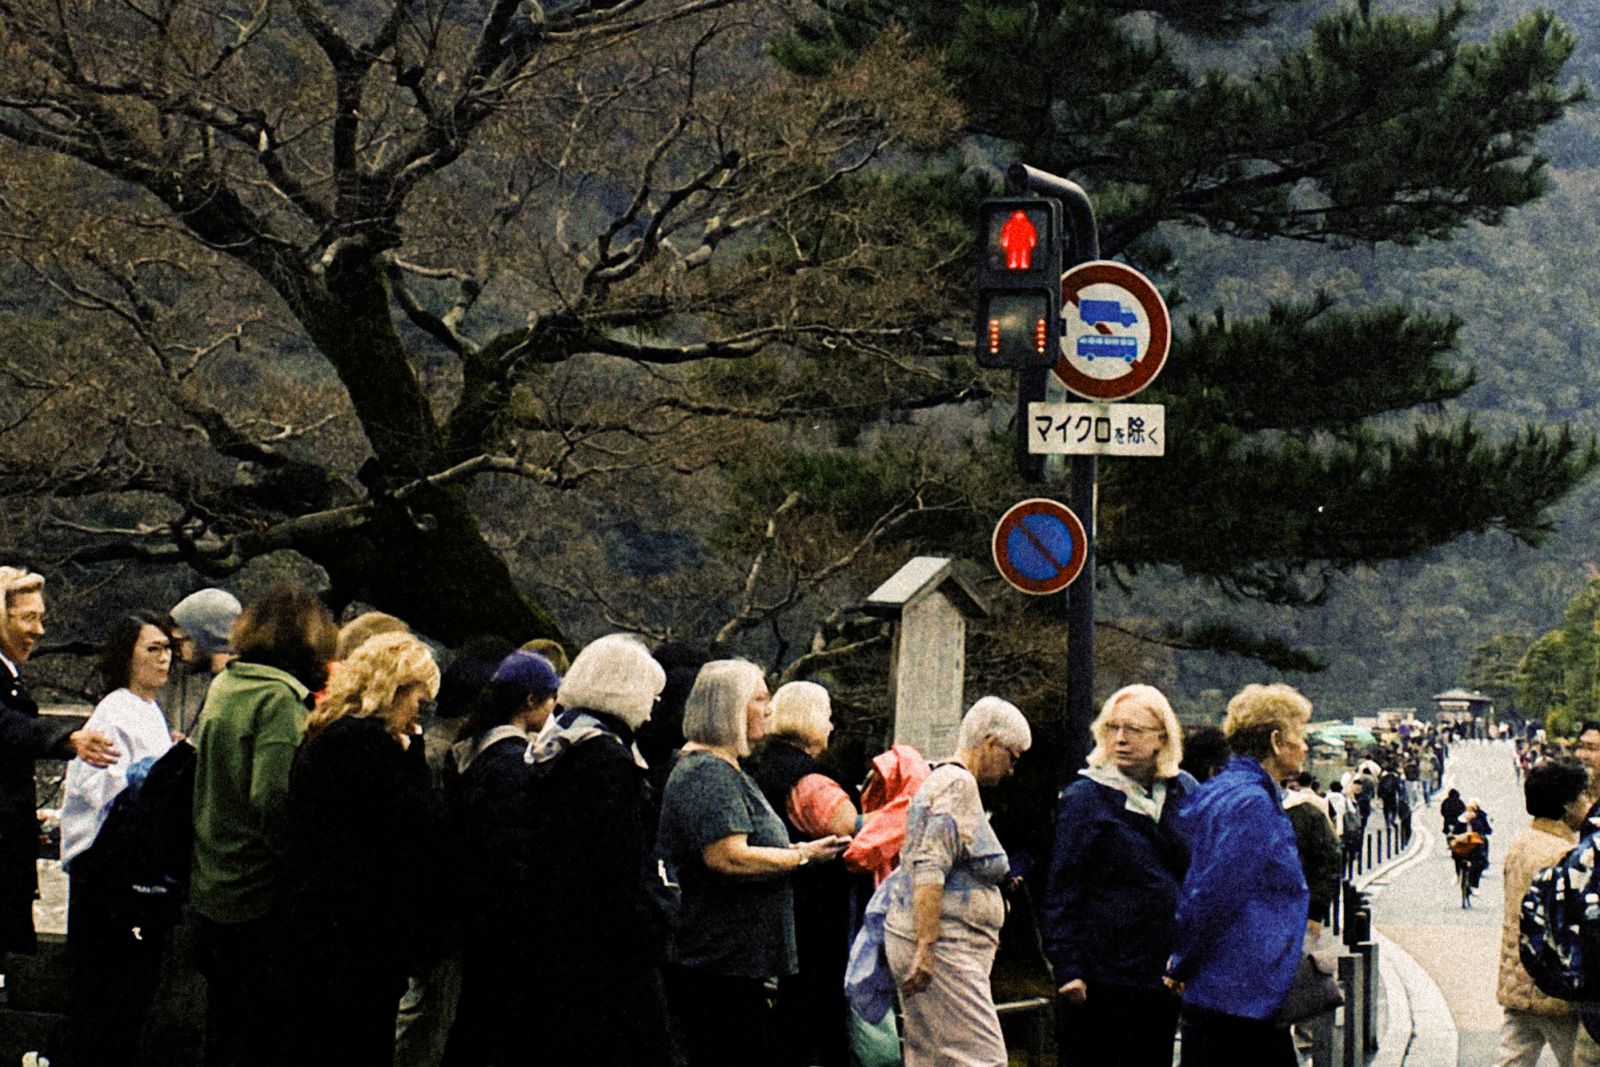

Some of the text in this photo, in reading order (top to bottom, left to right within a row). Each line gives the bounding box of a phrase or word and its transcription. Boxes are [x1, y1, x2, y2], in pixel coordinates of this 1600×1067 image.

[1035, 415, 1158, 445] マイクロを除く
